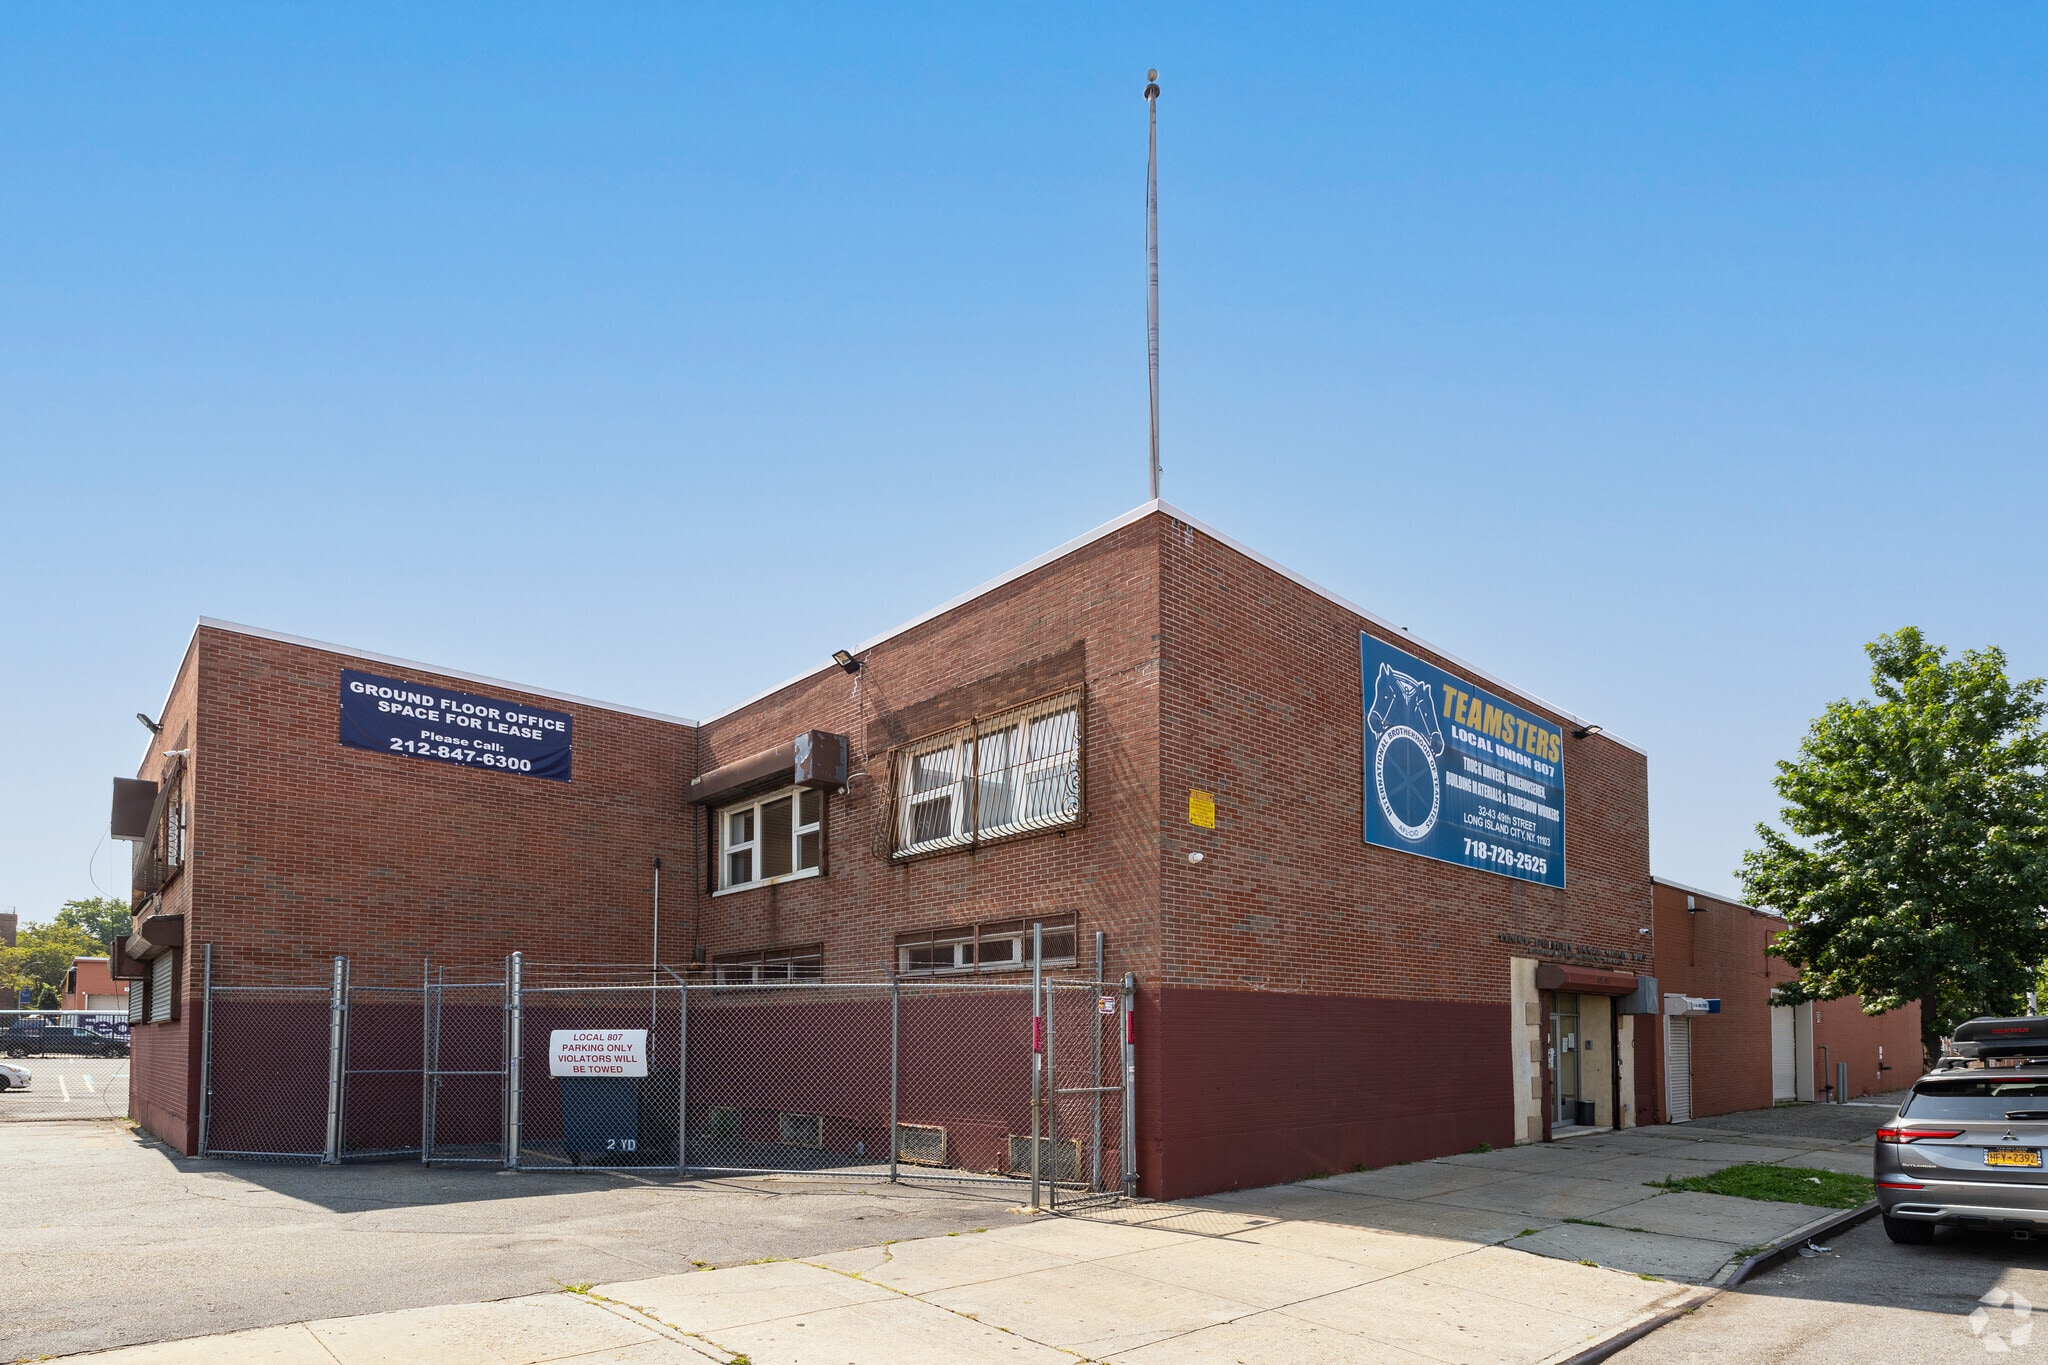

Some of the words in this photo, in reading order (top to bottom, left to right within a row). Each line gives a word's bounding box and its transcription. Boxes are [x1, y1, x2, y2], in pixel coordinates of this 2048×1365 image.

[350, 681, 434, 707] GROUND
[440, 699, 500, 720] FLOOR
[505, 711, 566, 732] OFFICE
[378, 701, 440, 722] SPACE
[446, 713, 482, 730] FOR
[487, 721, 543, 741] LEASE
[1443, 684, 1560, 763] TEAMSTERS
[389, 737, 532, 772] 212-847-6300
[421, 730, 469, 747] Please
[473, 739, 504, 753] Call:
[1451, 725, 1494, 753] LOCAL
[1495, 743, 1532, 769] UNION
[1533, 760, 1555, 778] 807
[1388, 728, 1431, 758] BROTHERHOOD
[1425, 778, 1439, 829] TEAMSTERS
[1463, 756, 1482, 776] TRUCK
[1446, 770, 1472, 793] BUILDING
[1472, 780, 1502, 803] MATERIALS
[1537, 803, 1560, 822] WORKERS
[1463, 812, 1484, 827] LONG
[1484, 819, 1509, 835] ISLAND
[1510, 827, 1526, 841] CITY,
[1478, 805, 1496, 819] 32-43
[1497, 811, 1511, 825] 49th
[1512, 816, 1537, 832] STREET
[1463, 837, 1548, 875] 718-726-2525
[562, 1044, 605, 1052] PARKING
[606, 1044, 633, 1052] ONLY
[573, 1033, 605, 1041] LOCAL
[607, 1033, 624, 1041] 807
[558, 1055, 612, 1063] VIOLATORS
[614, 1055, 638, 1063] WILL
[573, 1065, 586, 1073] BE
[588, 1065, 623, 1073] TOWED
[606, 1139, 615, 1150] 2
[620, 1139, 636, 1151] YD
